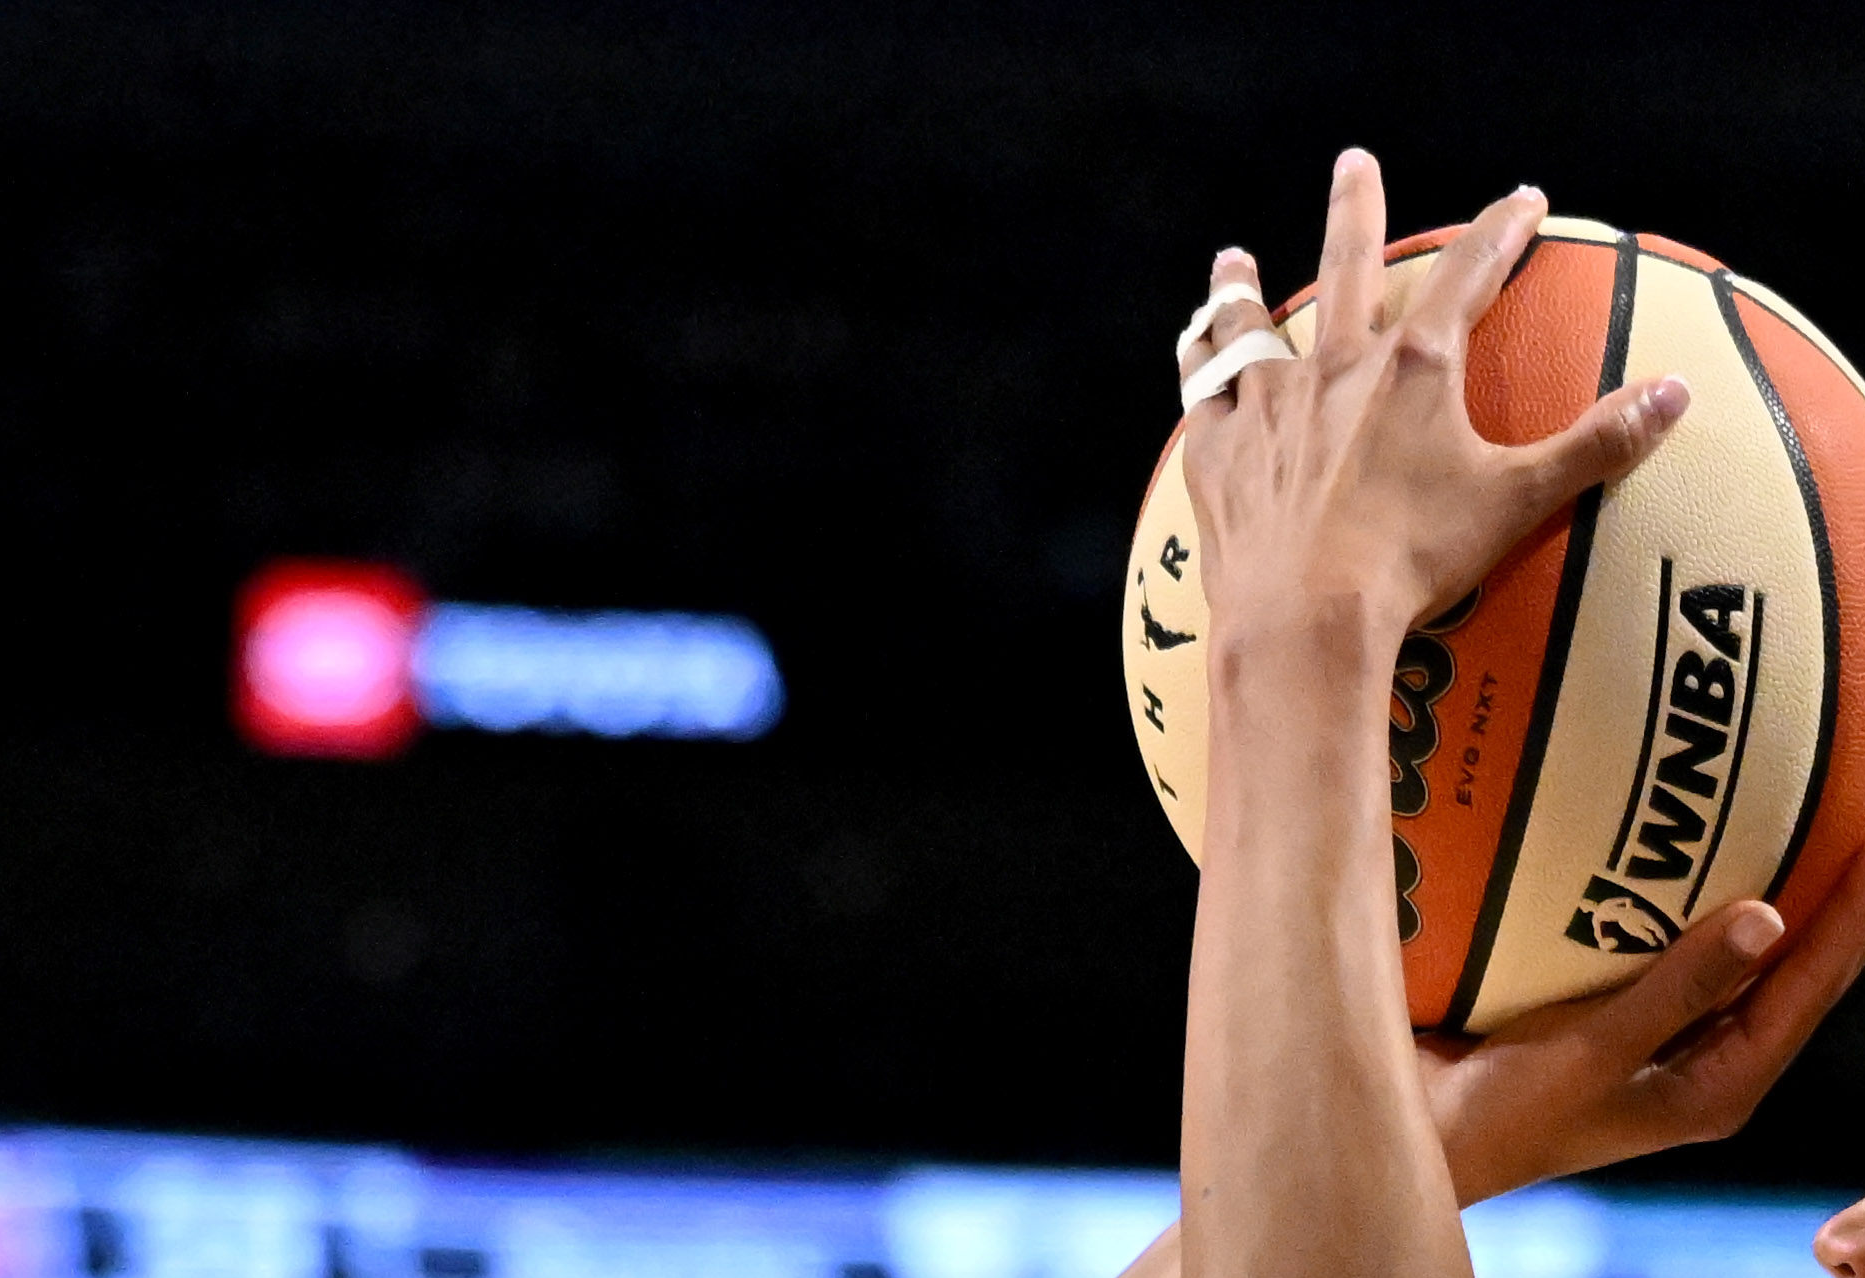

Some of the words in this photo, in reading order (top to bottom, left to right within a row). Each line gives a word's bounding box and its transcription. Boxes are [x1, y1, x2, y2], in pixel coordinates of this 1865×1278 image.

[1456, 745, 1482, 809] EVO
[1470, 671, 1499, 735] NXT
[1624, 584, 1746, 881] WNBA
